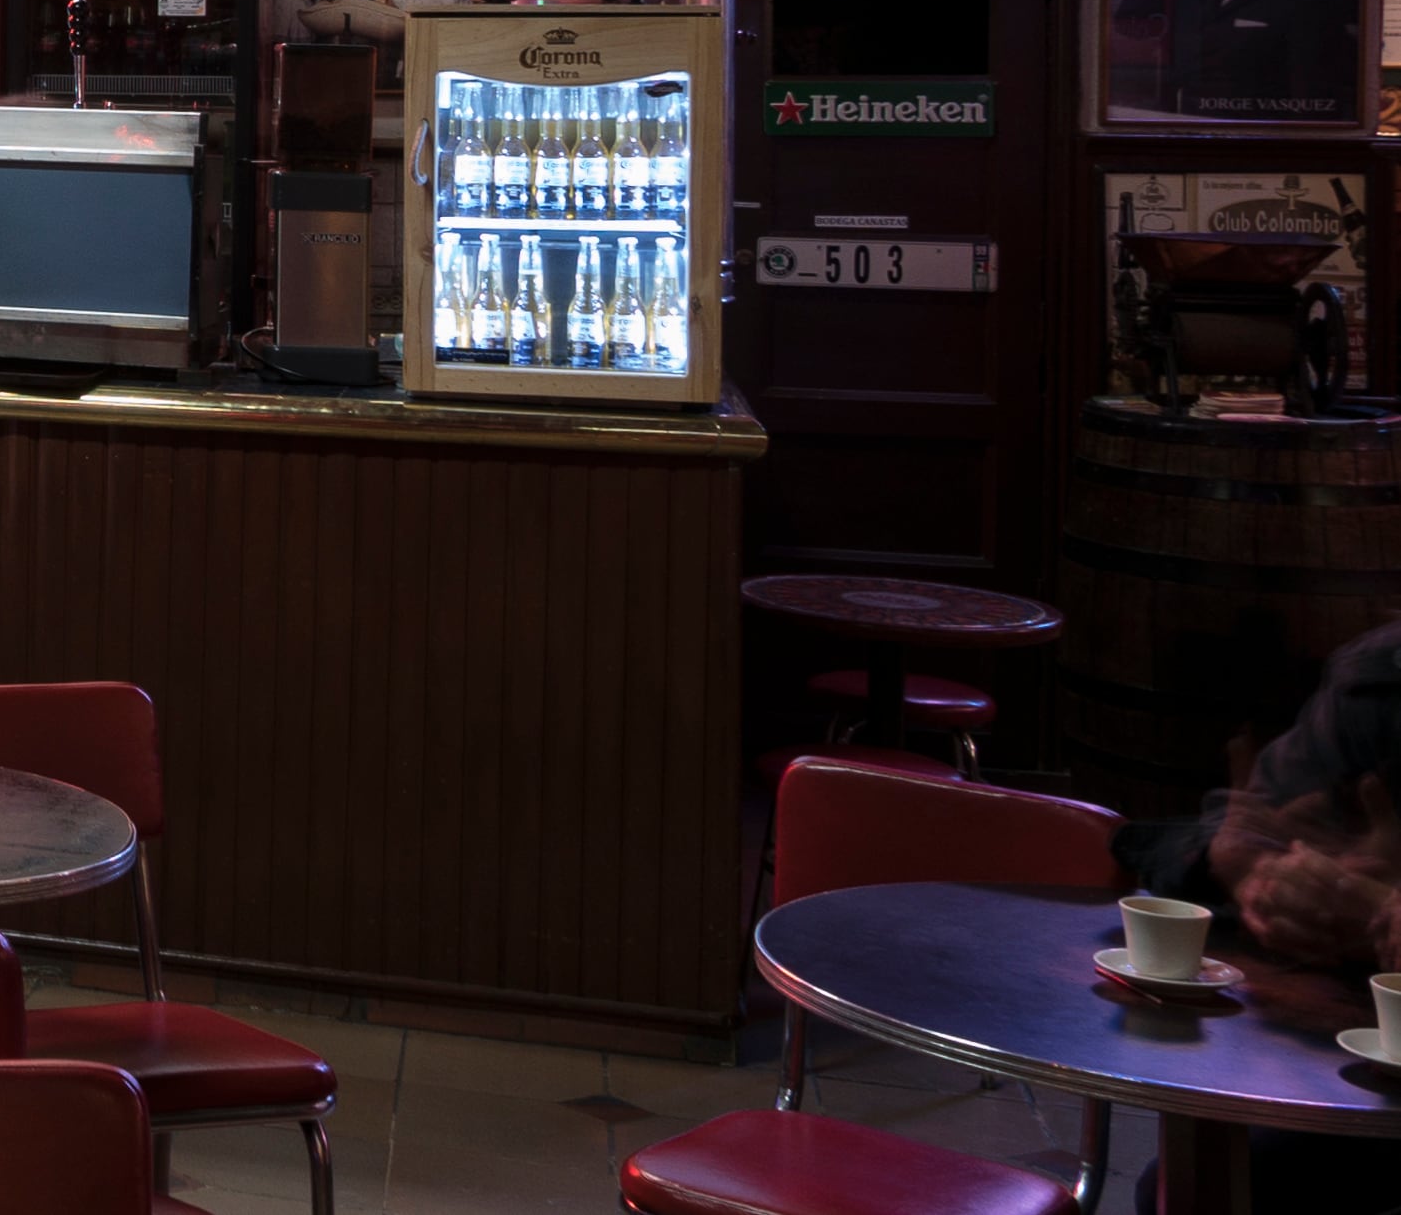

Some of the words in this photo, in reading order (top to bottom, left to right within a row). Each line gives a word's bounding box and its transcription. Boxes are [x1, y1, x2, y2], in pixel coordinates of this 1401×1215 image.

[519, 45, 604, 70] Corona
[543, 68, 580, 79] Extra
[809, 95, 986, 125] Heineken
[1198, 96, 1252, 112] JORGE
[1256, 96, 1337, 113] VASQUEZ
[816, 216, 856, 226] BODEGA
[1214, 210, 1250, 233] Club
[1255, 210, 1341, 234] Colombia
[313, 232, 361, 244] RANCILIO
